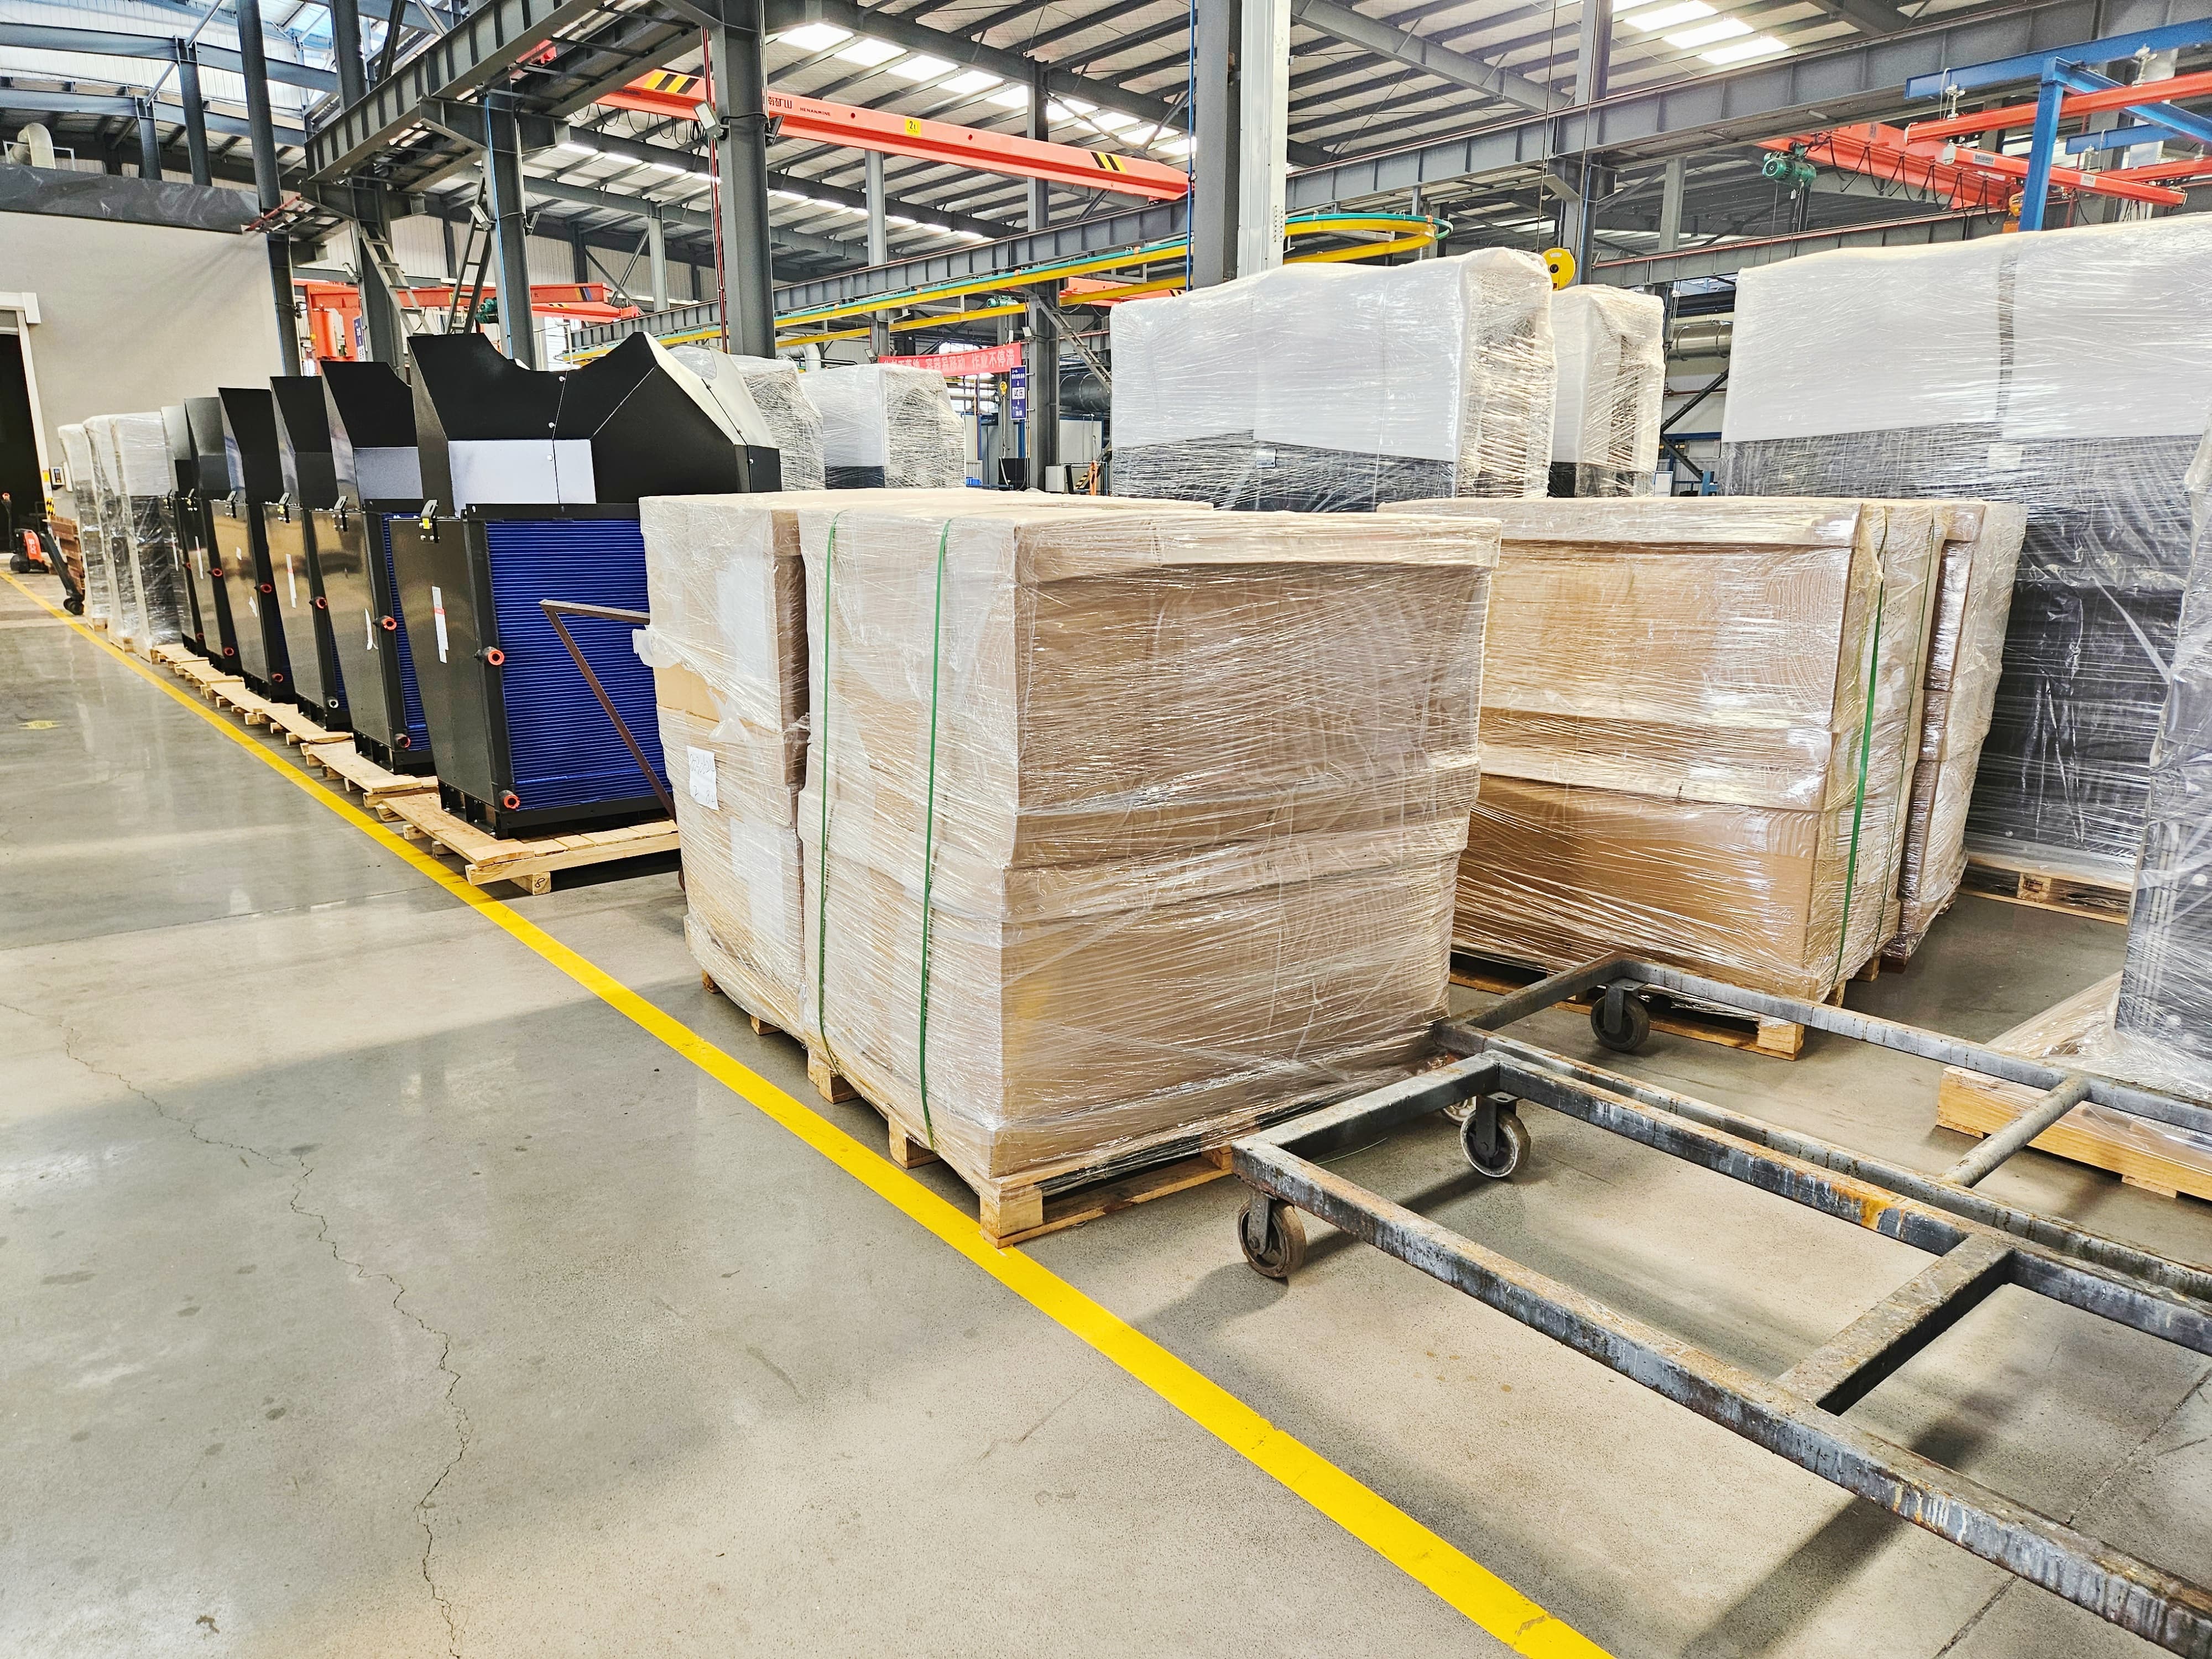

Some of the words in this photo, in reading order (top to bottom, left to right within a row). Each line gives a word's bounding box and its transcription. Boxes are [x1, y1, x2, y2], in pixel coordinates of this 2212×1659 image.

[800, 107, 831, 116] HENANMINE
[972, 348, 1014, 370] 作业不停滞
[535, 878, 545, 888] 8
